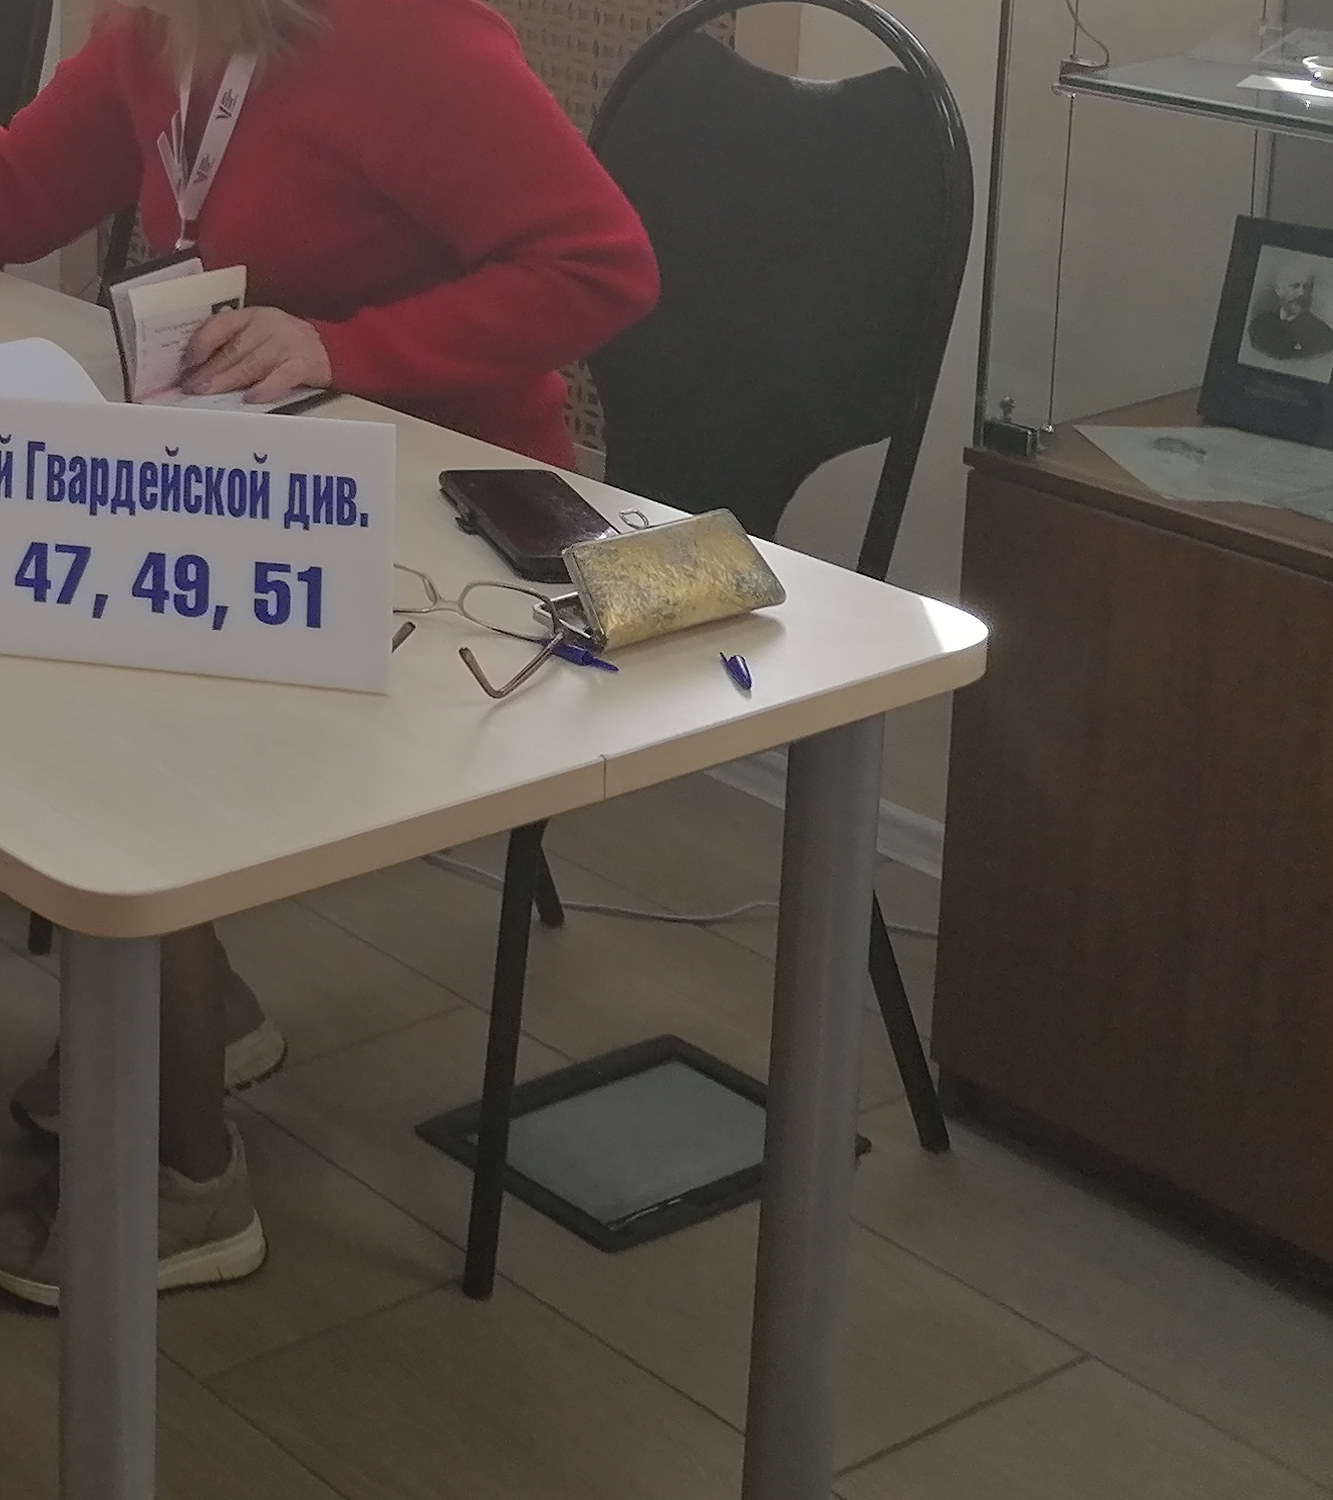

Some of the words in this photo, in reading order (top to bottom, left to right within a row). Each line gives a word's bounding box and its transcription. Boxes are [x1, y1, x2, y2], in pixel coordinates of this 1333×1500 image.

[26, 441, 270, 520] Гвардейской
[284, 473, 369, 531] див.
[14, 541, 109, 619] 47,
[132, 551, 229, 631] 49,
[253, 561, 323, 629] 51
